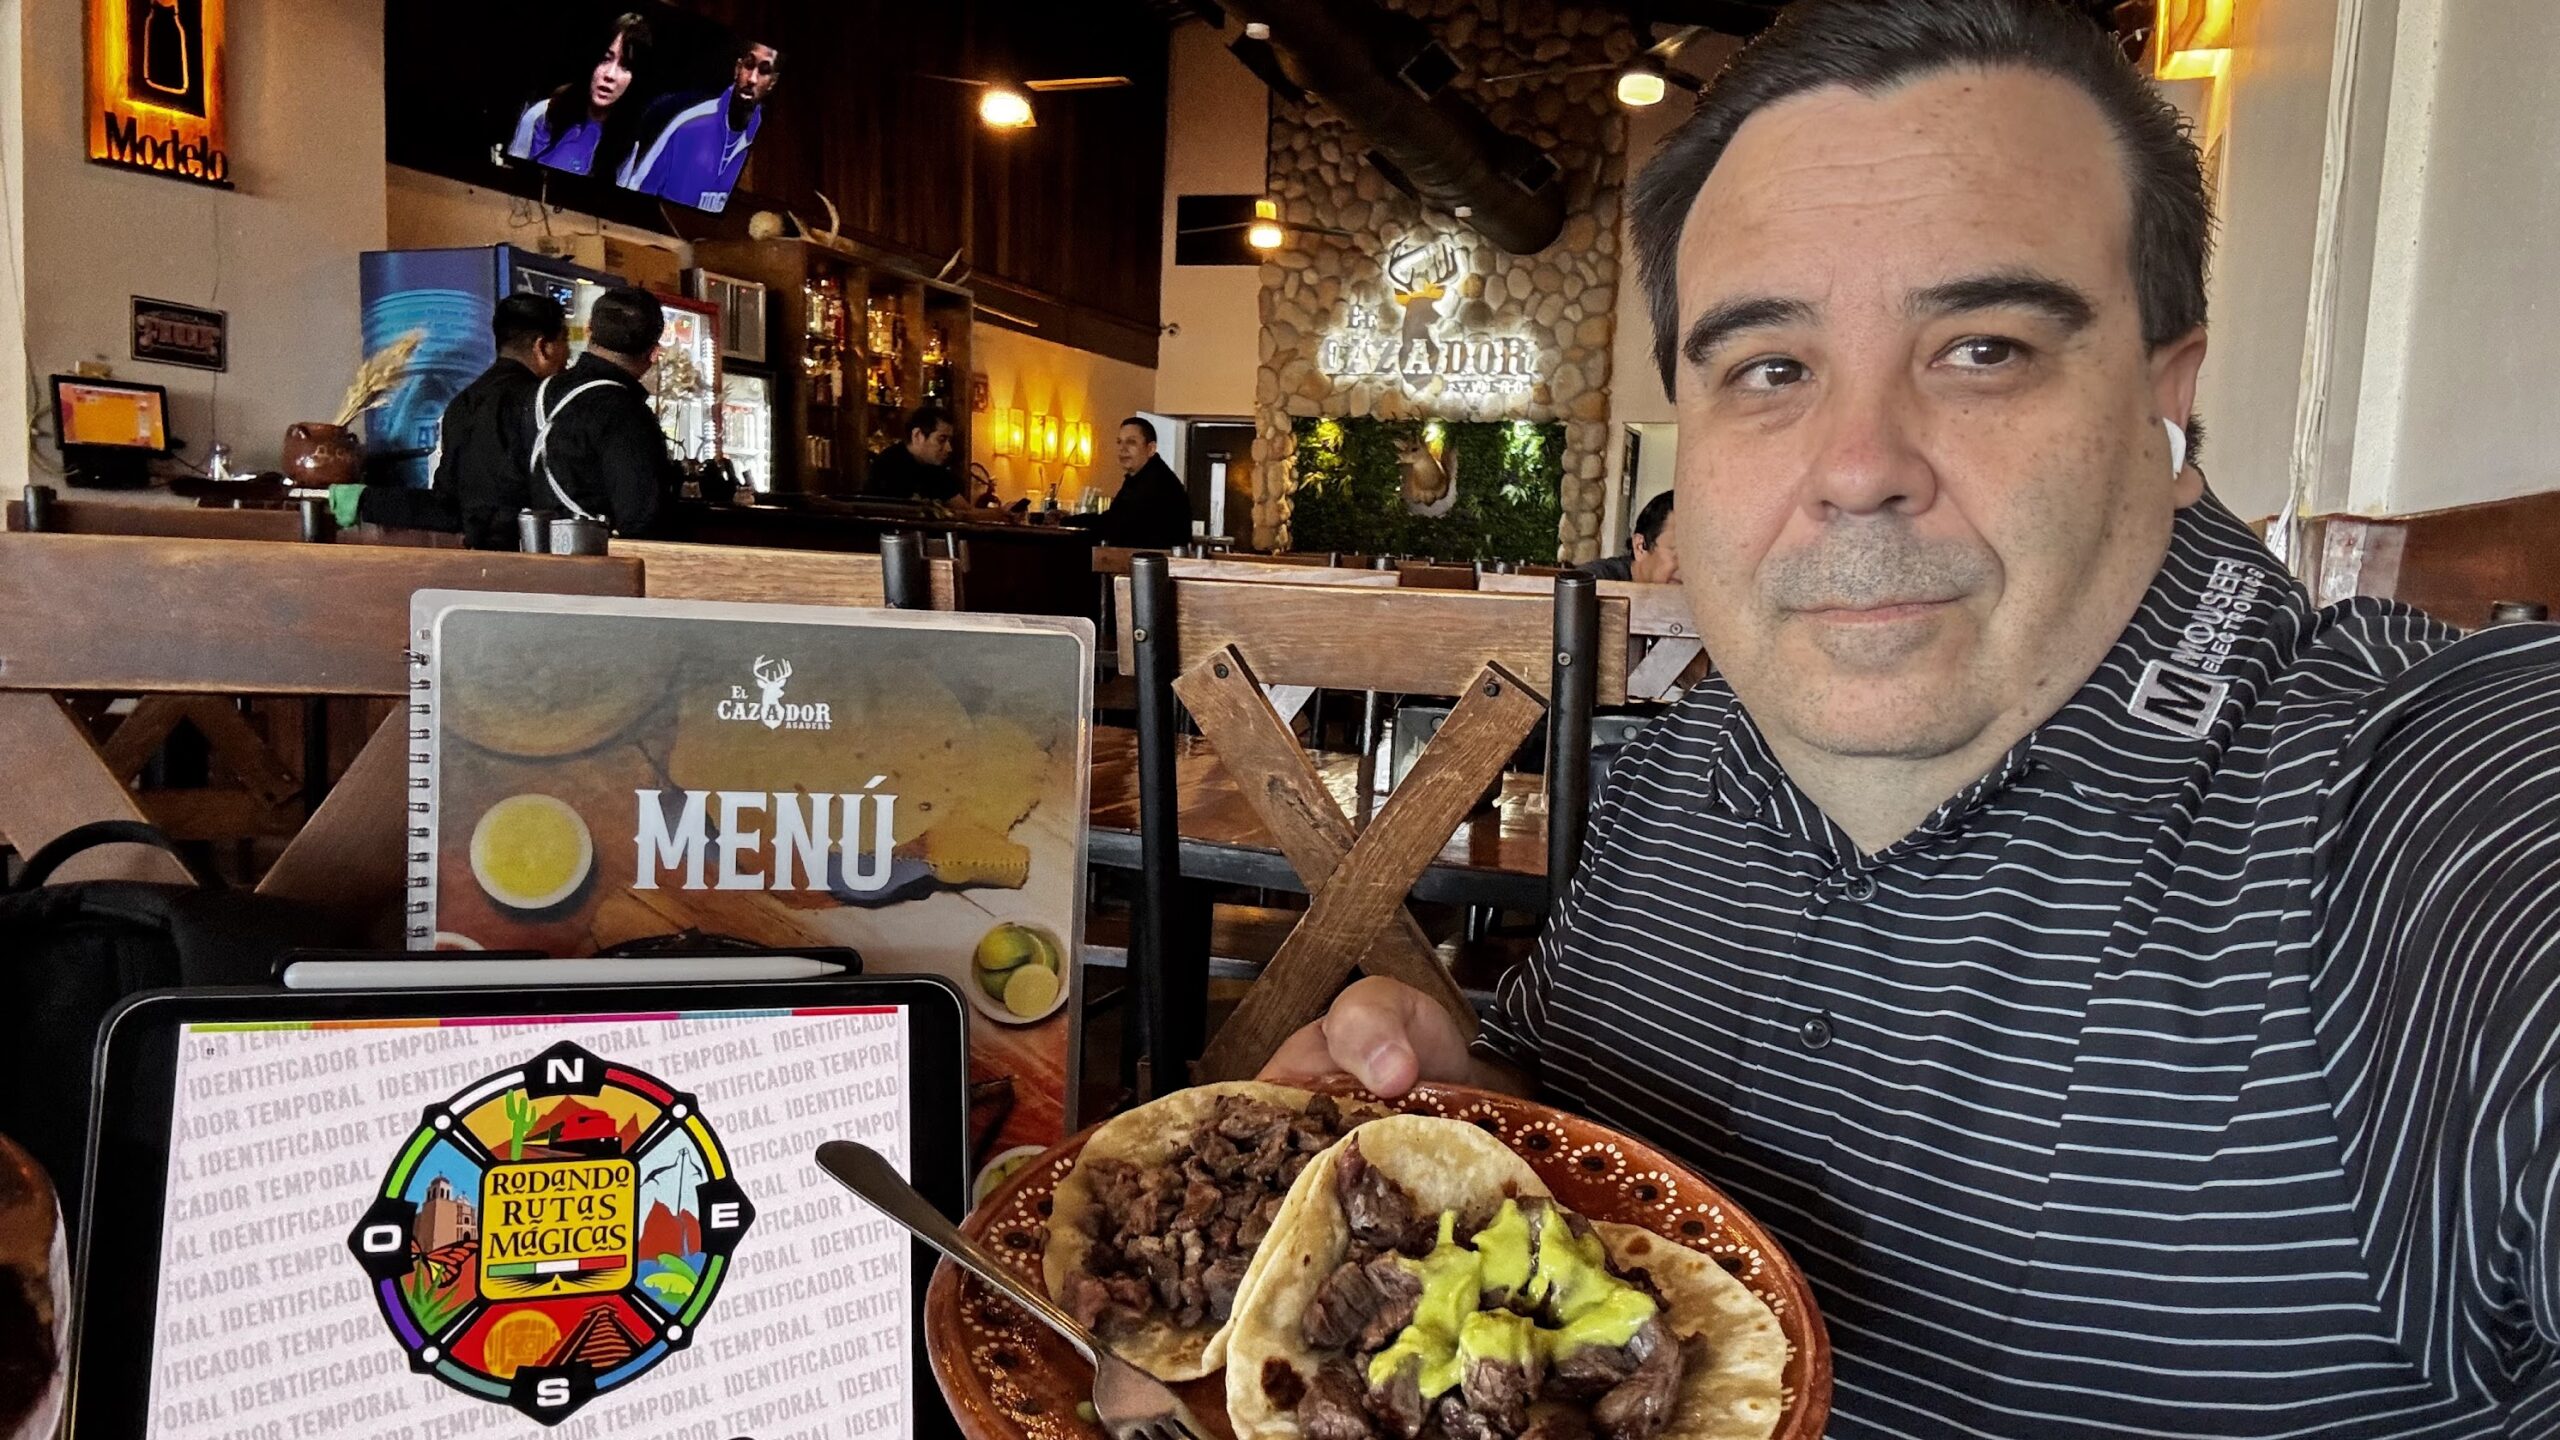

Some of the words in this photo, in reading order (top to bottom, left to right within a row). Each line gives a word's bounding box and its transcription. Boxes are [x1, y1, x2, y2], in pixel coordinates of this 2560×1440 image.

[104, 111, 228, 181] Modelo
[1322, 337, 1535, 375] CAZADOR
[2170, 560, 2245, 667] MOUSER
[2202, 567, 2266, 673] ELECTRONICS
[717, 700, 833, 723] CAZADOR
[731, 685, 749, 699] EL
[785, 721, 831, 730] ASADERO
[632, 775, 899, 891] MENÚ
[575, 1025, 649, 1054] PORAL
[658, 1037, 763, 1077] TEMPORAL
[189, 1047, 358, 1100] IDENTIFICADOR
[363, 1028, 478, 1067] TEMPORAL
[547, 1058, 584, 1084] N
[244, 1083, 366, 1129] TEMPORAL
[198, 1120, 369, 1177] IDENTIFICADOR
[255, 1158, 376, 1203] TEMPORAL
[711, 1202, 739, 1229] E
[750, 1195, 842, 1239] IFICADOR
[363, 1225, 402, 1256] O
[712, 1264, 856, 1324] IDENTIFICADOR
[709, 1314, 816, 1362] TEMPORAL
[231, 1349, 404, 1416] IDENTIFICADOR
[537, 1378, 570, 1407] S
[603, 1382, 714, 1433] TEMPORAL
[724, 1335, 869, 1398] IDENTIFICADOR
[288, 1386, 412, 1439] TEMPORAL
[722, 1387, 828, 1435] TEMPORAL
